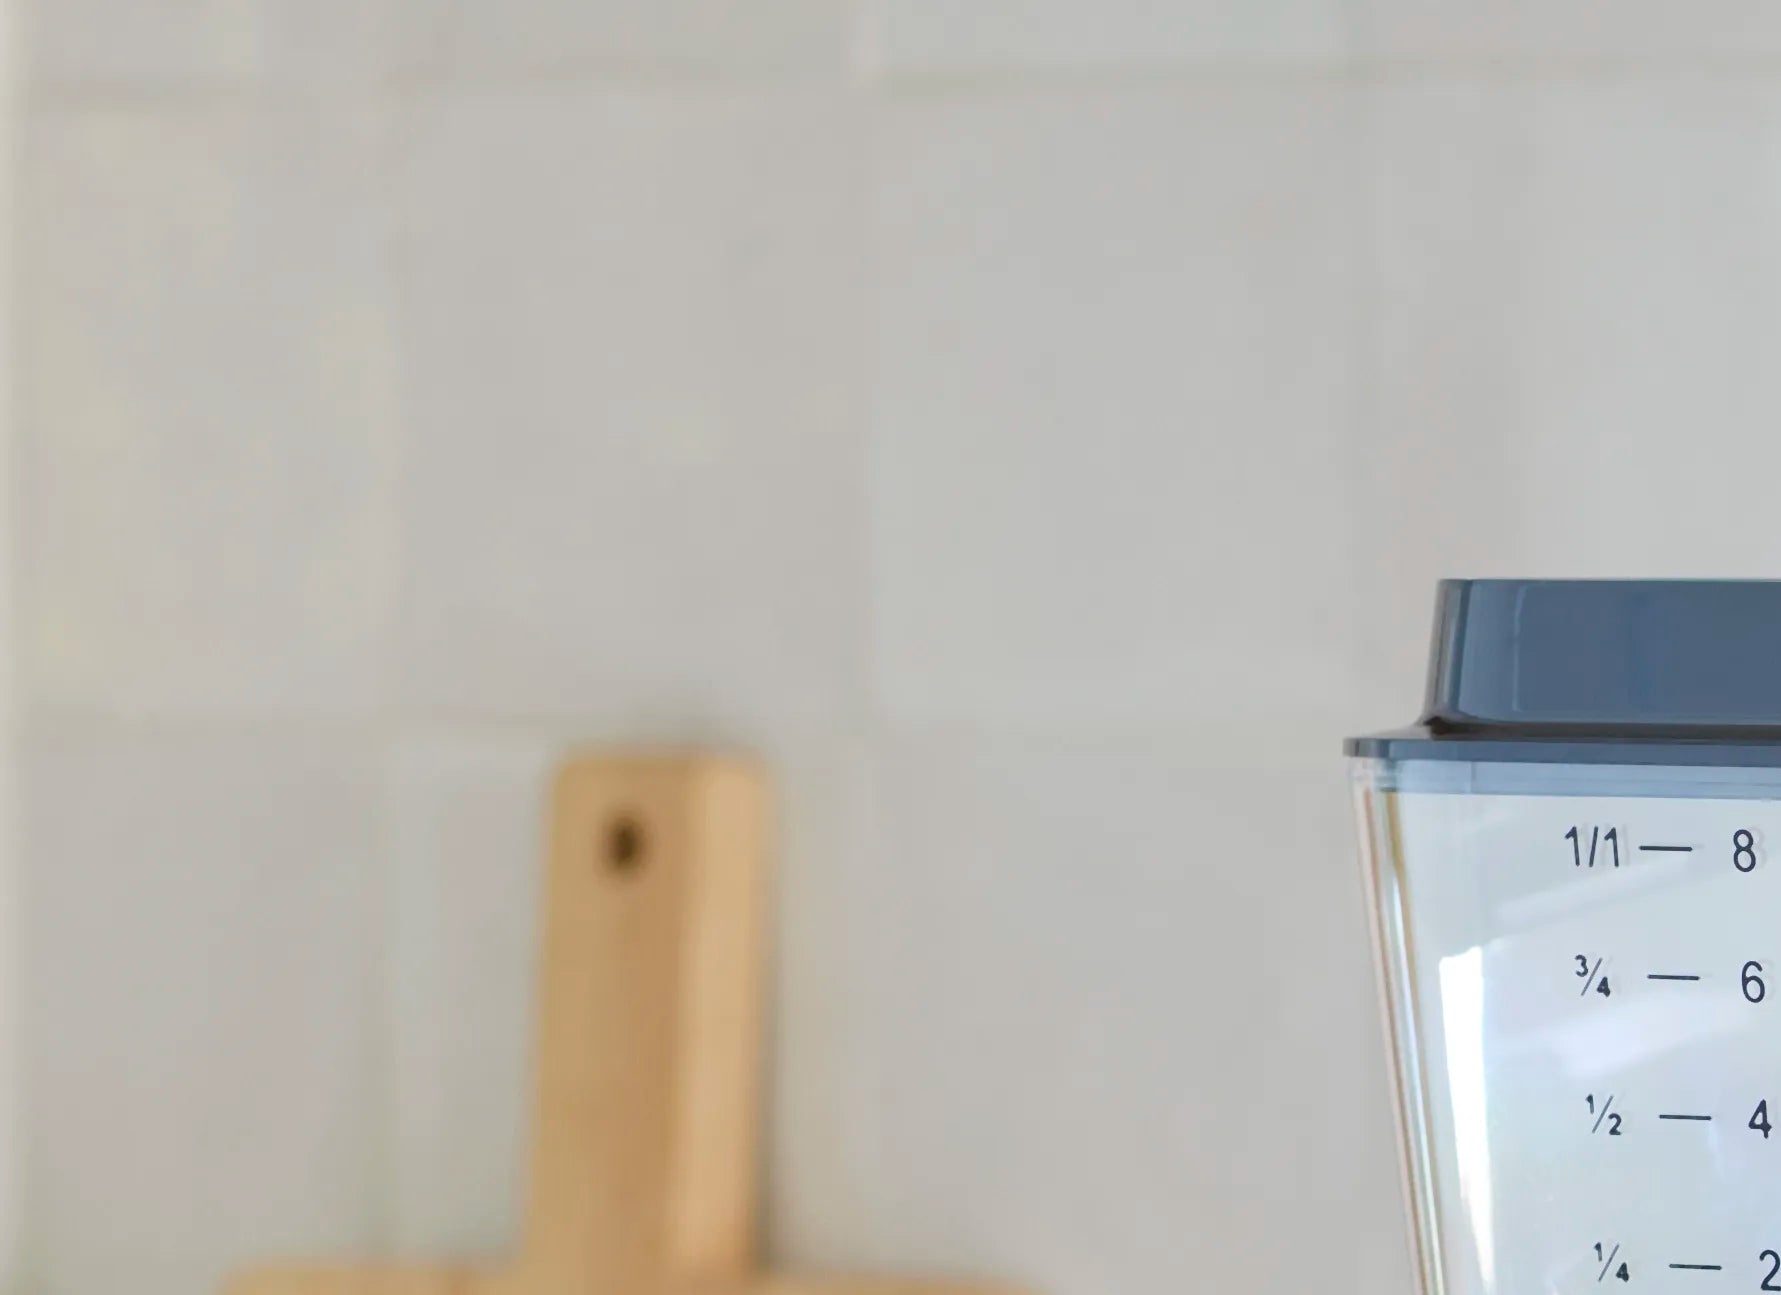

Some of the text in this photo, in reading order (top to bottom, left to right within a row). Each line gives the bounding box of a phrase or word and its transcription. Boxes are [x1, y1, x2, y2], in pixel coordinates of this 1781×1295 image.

[1564, 826, 1757, 873] 1/1 8
[1741, 960, 1766, 1004] 6
[1748, 1098, 1773, 1140] 4
